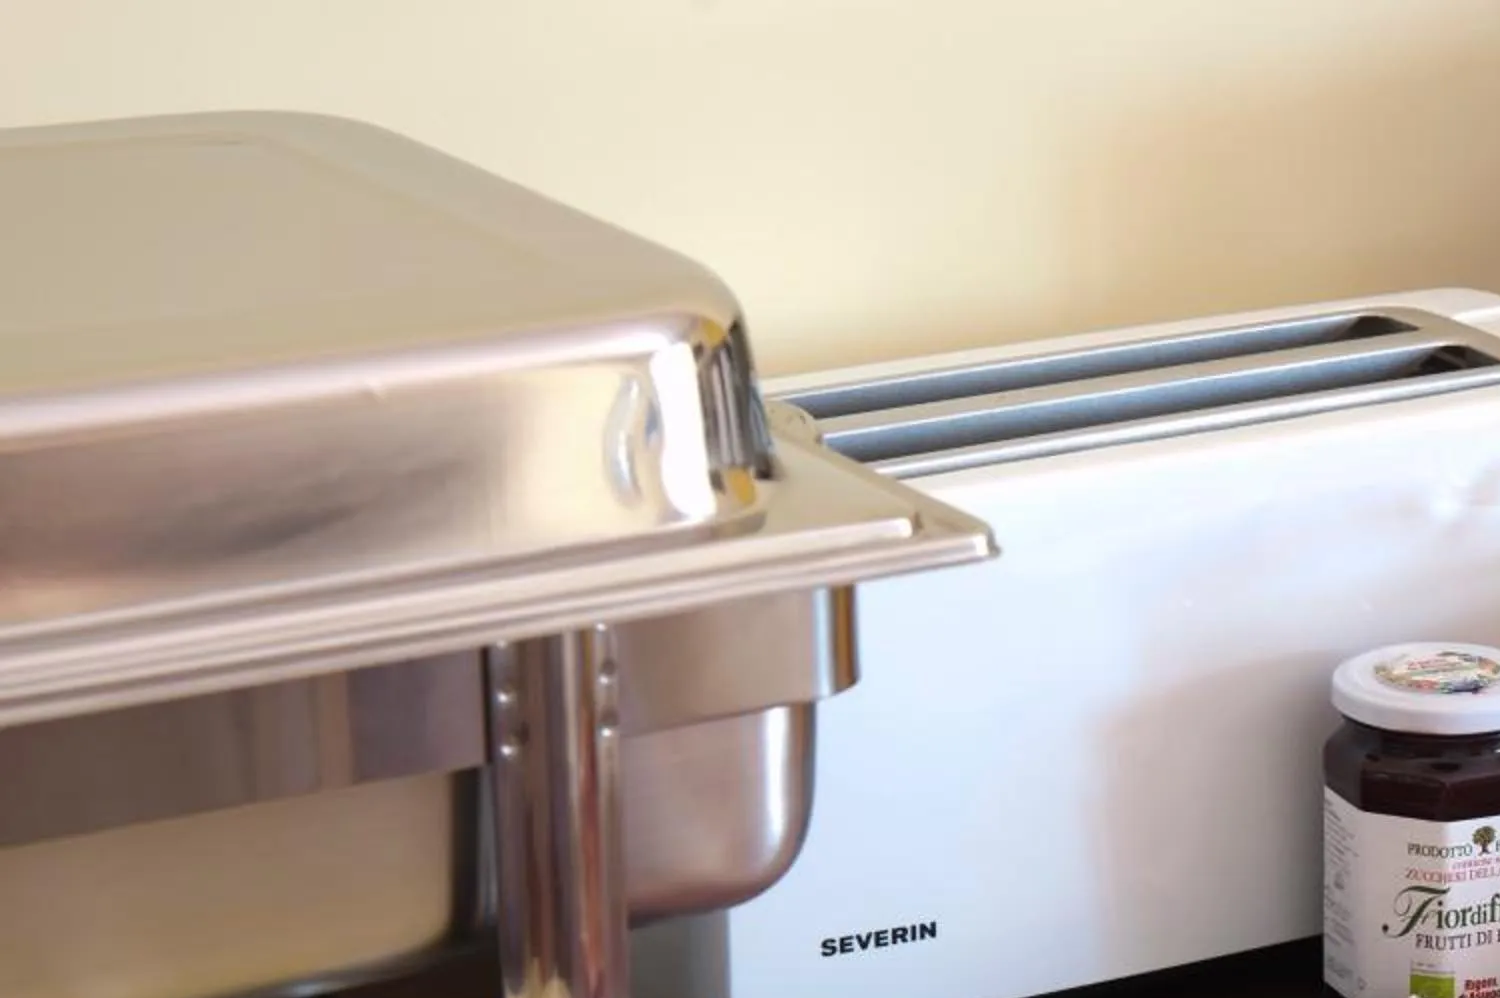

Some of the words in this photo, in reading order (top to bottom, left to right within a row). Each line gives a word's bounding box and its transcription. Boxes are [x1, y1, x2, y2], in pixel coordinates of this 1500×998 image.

[1407, 842, 1473, 859] PRODOTTO
[820, 921, 937, 957] SEVERIN
[1415, 933, 1472, 951] FRUTTI
[1475, 929, 1494, 946] DI
